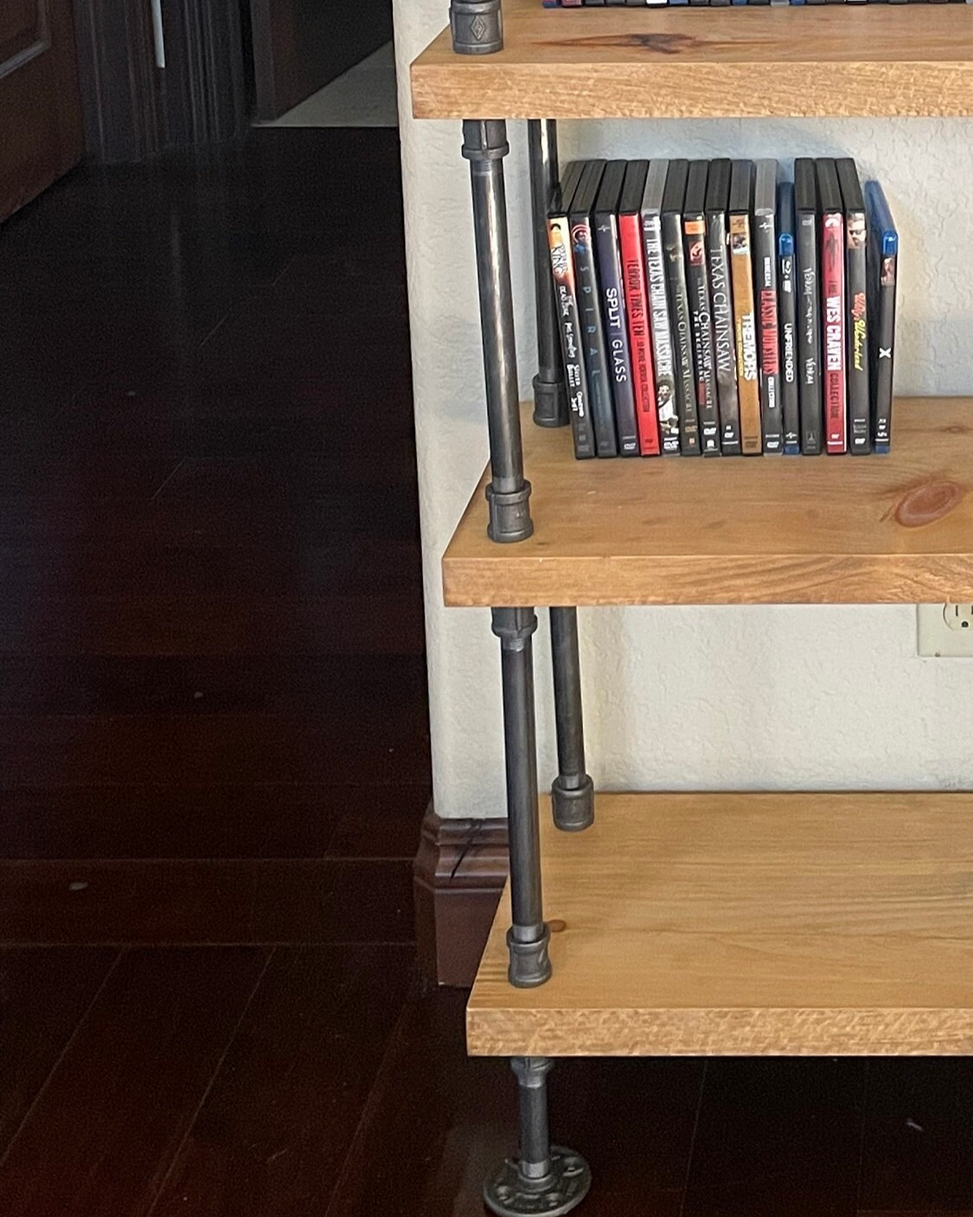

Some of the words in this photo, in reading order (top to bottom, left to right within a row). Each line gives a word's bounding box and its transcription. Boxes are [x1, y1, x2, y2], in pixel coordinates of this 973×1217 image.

[646, 238, 658, 255] THE
[627, 259, 639, 291] TERROR
[648, 256, 661, 282] TEXAS
[710, 248, 726, 289] TEXAS
[606, 288, 620, 328] SPLIT
[629, 294, 641, 318] TIMES
[652, 311, 666, 330] SAW
[826, 296, 840, 323] WES
[632, 321, 643, 336] TEN
[698, 312, 710, 369] CHAINSAW
[714, 292, 730, 372] CHAINSAW
[743, 311, 756, 380] TREMORS
[827, 325, 841, 370] CRAVEN
[612, 340, 626, 382] GLASS
[654, 332, 670, 376] MASSACRE
[695, 332, 704, 382] BEGINNING
[784, 323, 793, 382] UNFRIENDED
[879, 347, 891, 358] X
